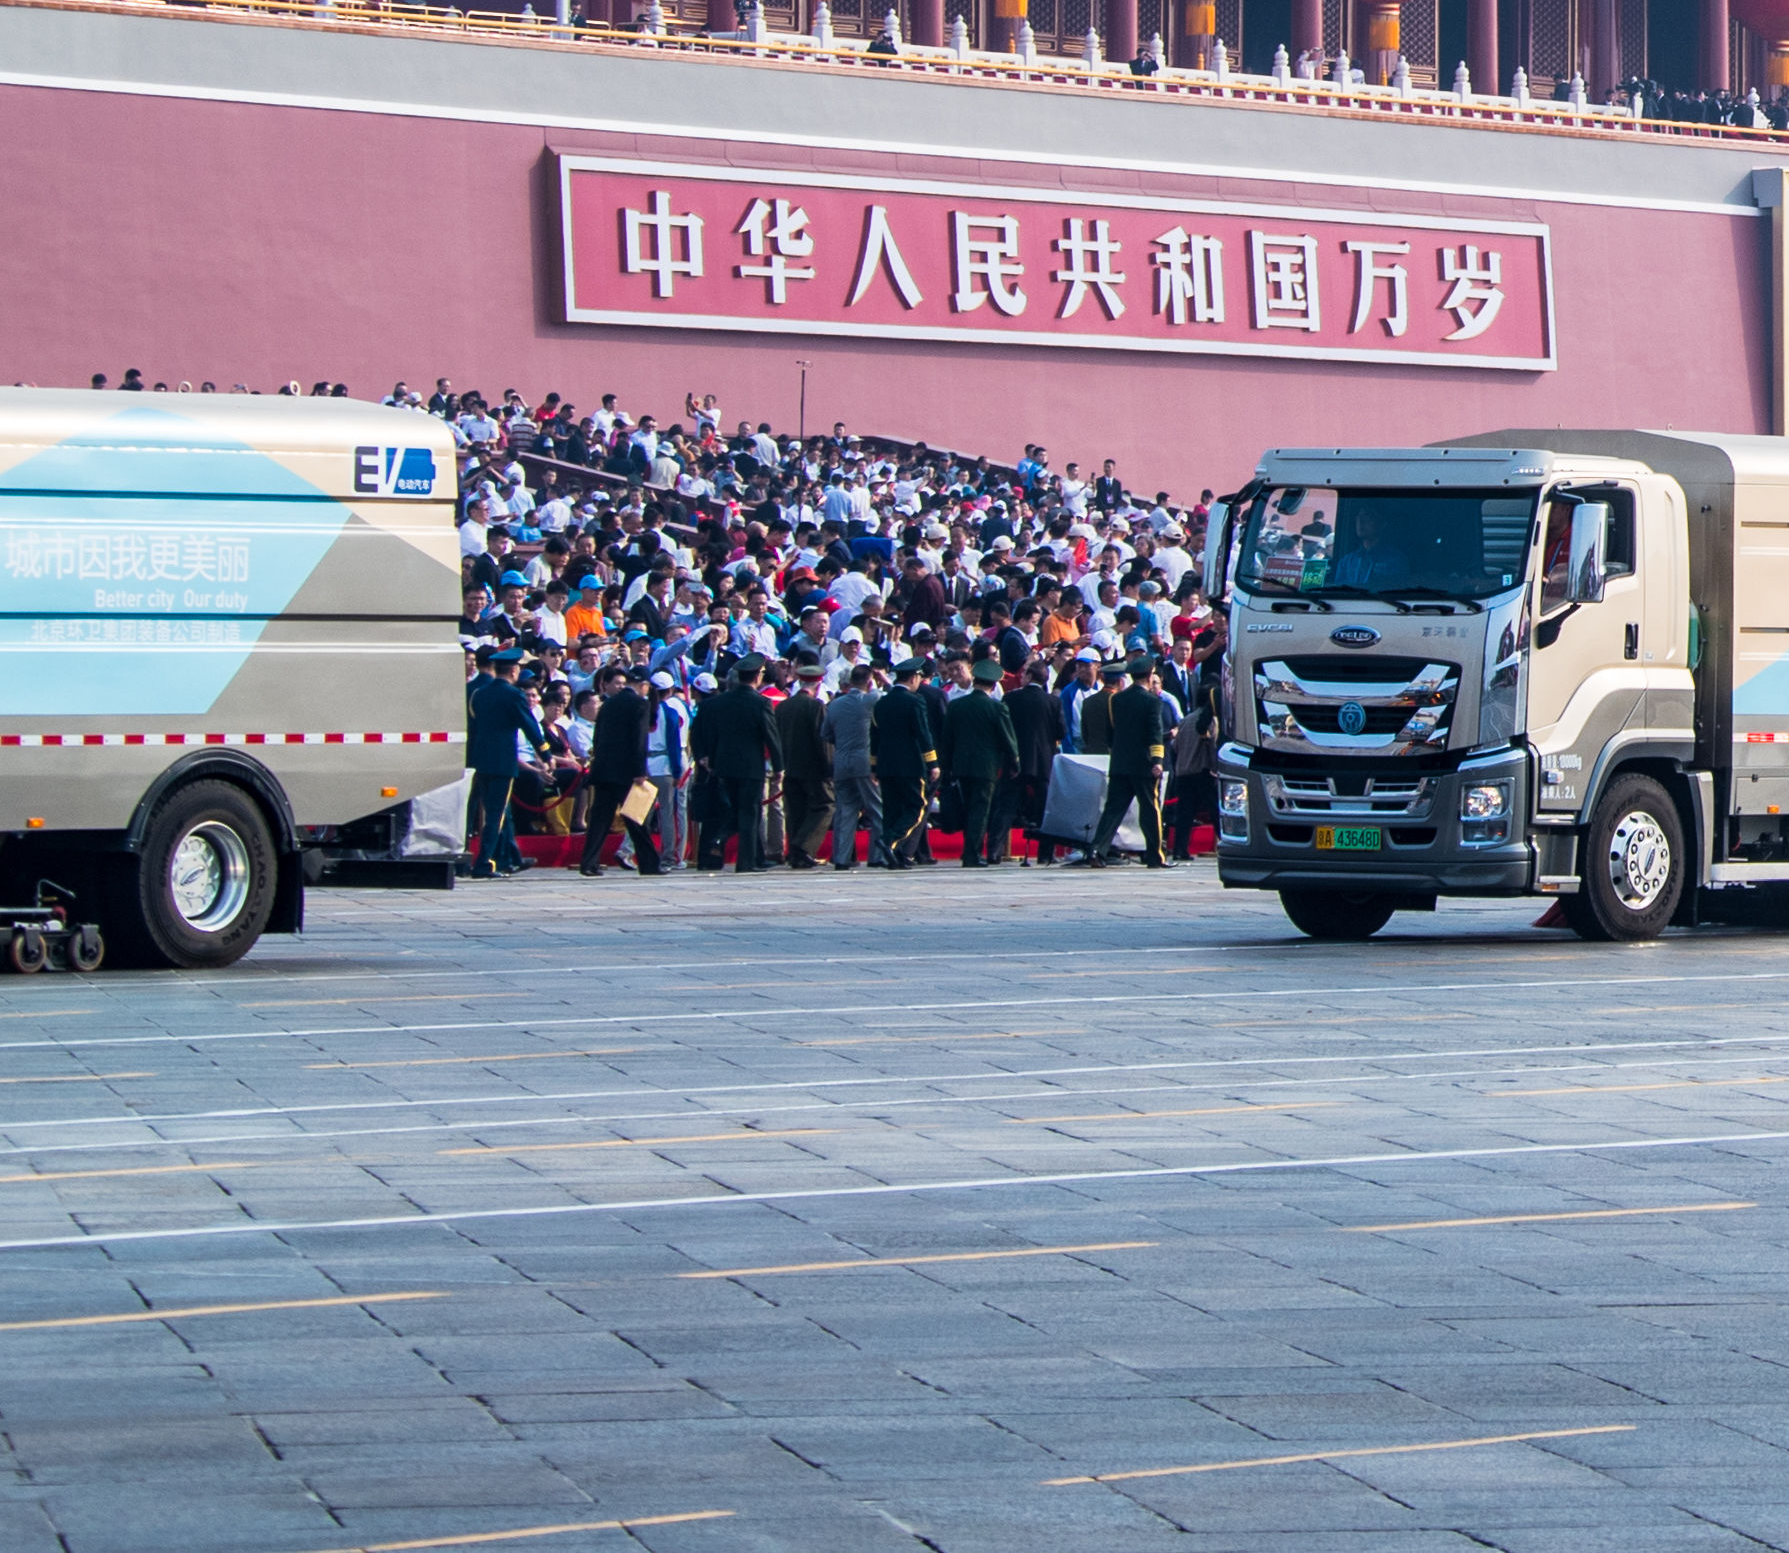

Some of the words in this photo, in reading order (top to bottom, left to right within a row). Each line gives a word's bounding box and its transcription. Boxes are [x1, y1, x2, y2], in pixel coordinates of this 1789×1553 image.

[618, 189, 1506, 343] 中华人民共和国万岁
[4, 530, 251, 582] 城市因我更美丽
[94, 589, 144, 608] Better
[147, 589, 175, 611] city
[184, 589, 212, 608] Our
[215, 591, 249, 612] duty
[31, 620, 241, 642] 北京环卫集团装备公司制造
